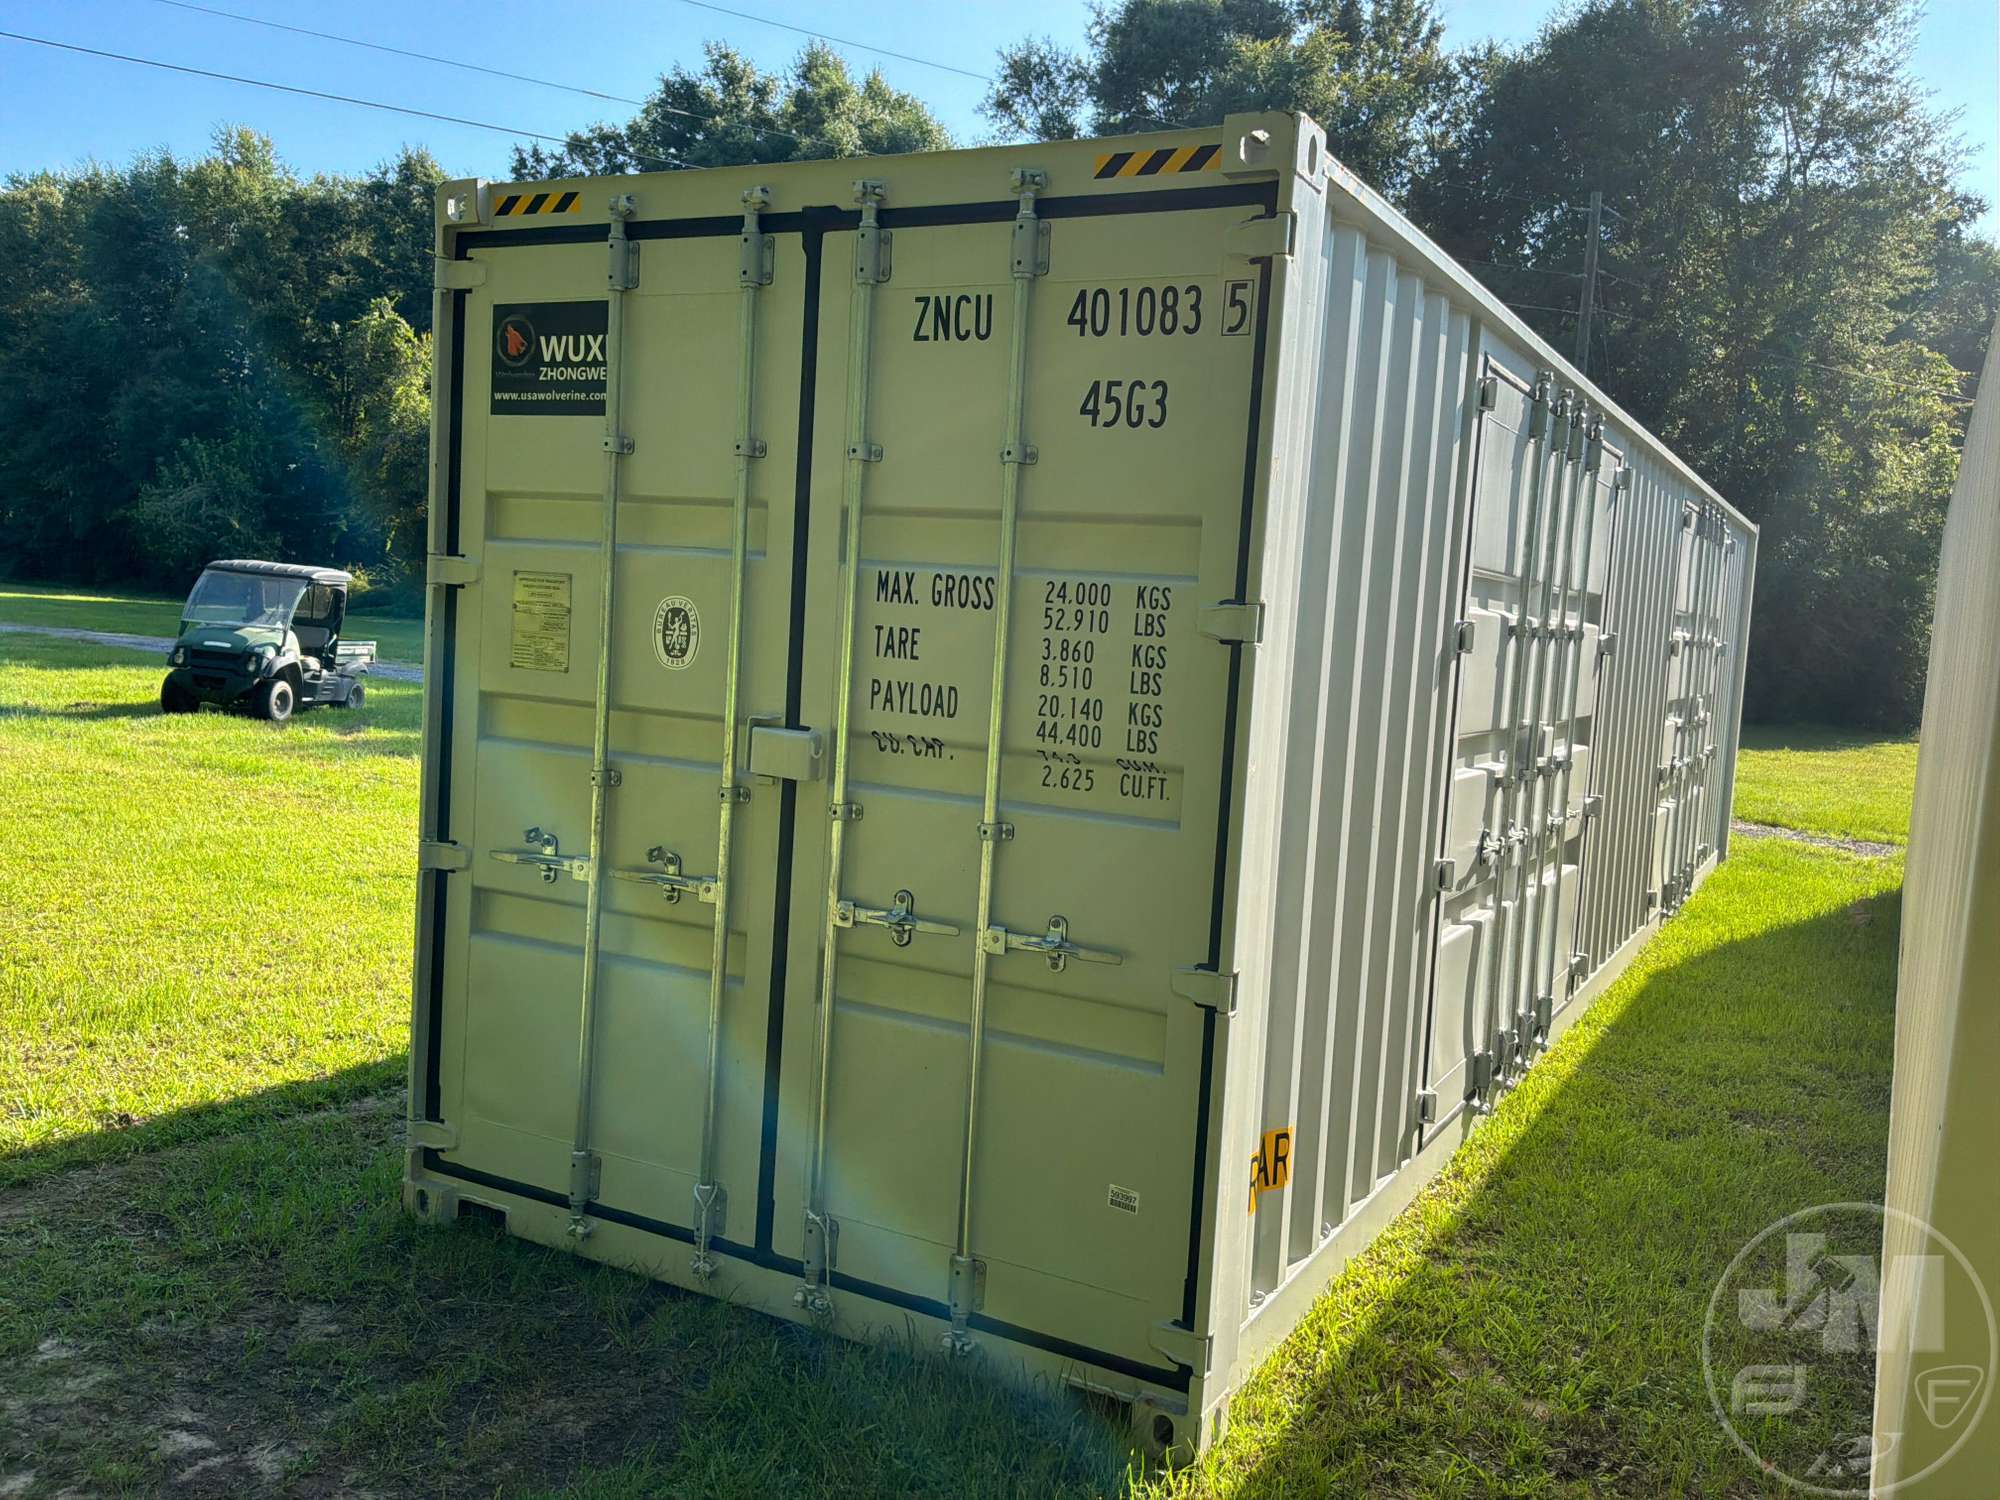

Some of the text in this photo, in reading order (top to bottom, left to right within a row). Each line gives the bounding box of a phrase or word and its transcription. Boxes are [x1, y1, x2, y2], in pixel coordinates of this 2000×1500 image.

[913, 281, 1250, 342] ZNCU 401083 5
[1079, 380, 1168, 428] 45G3
[876, 570, 995, 611] MAX. GROSS
[1136, 585, 1171, 610] KGS
[1134, 613, 1166, 638] LBS
[875, 625, 921, 660] TARE
[1131, 644, 1167, 669] KGS
[870, 678, 959, 718] PAYLOAD
[1128, 703, 1163, 728] KGS
[1130, 671, 1163, 696] LBS
[1126, 730, 1159, 754] LBS
